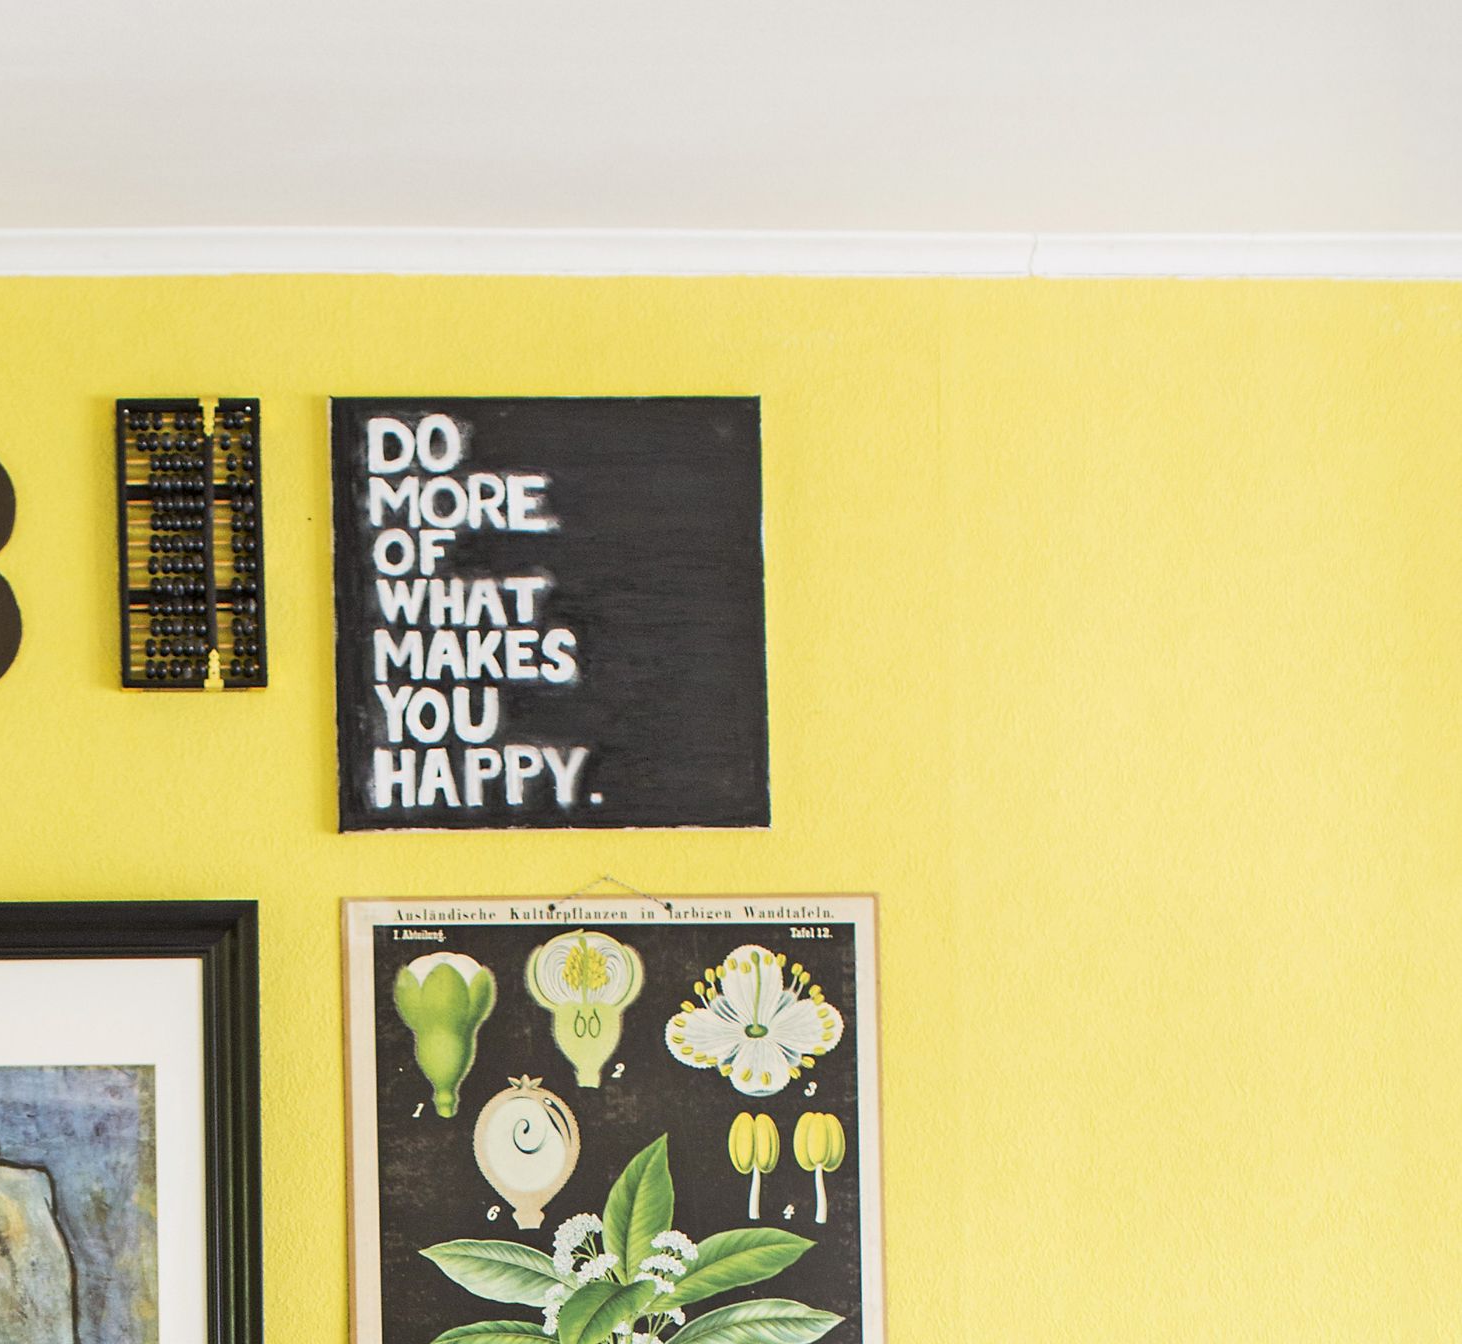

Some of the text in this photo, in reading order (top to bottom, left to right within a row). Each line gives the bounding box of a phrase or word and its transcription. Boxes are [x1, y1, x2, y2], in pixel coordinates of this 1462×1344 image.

[367, 414, 462, 473] DO
[367, 473, 556, 532] MORE
[372, 528, 456, 576] OF
[375, 576, 548, 626] WHAT
[373, 628, 578, 683] MAKES
[374, 684, 499, 744] YOU
[371, 744, 603, 807] HAPPY.
[394, 908, 497, 921] Ausländische
[510, 907, 628, 923] Kulturpflanzen
[641, 907, 655, 919] in
[669, 907, 732, 920] farbigen
[790, 927, 815, 939] Tafel
[611, 1063, 626, 1079] 2
[803, 1081, 818, 1098] 3
[412, 1103, 425, 1118] 1
[486, 1205, 501, 1222] 6
[782, 1204, 796, 1221] 4
